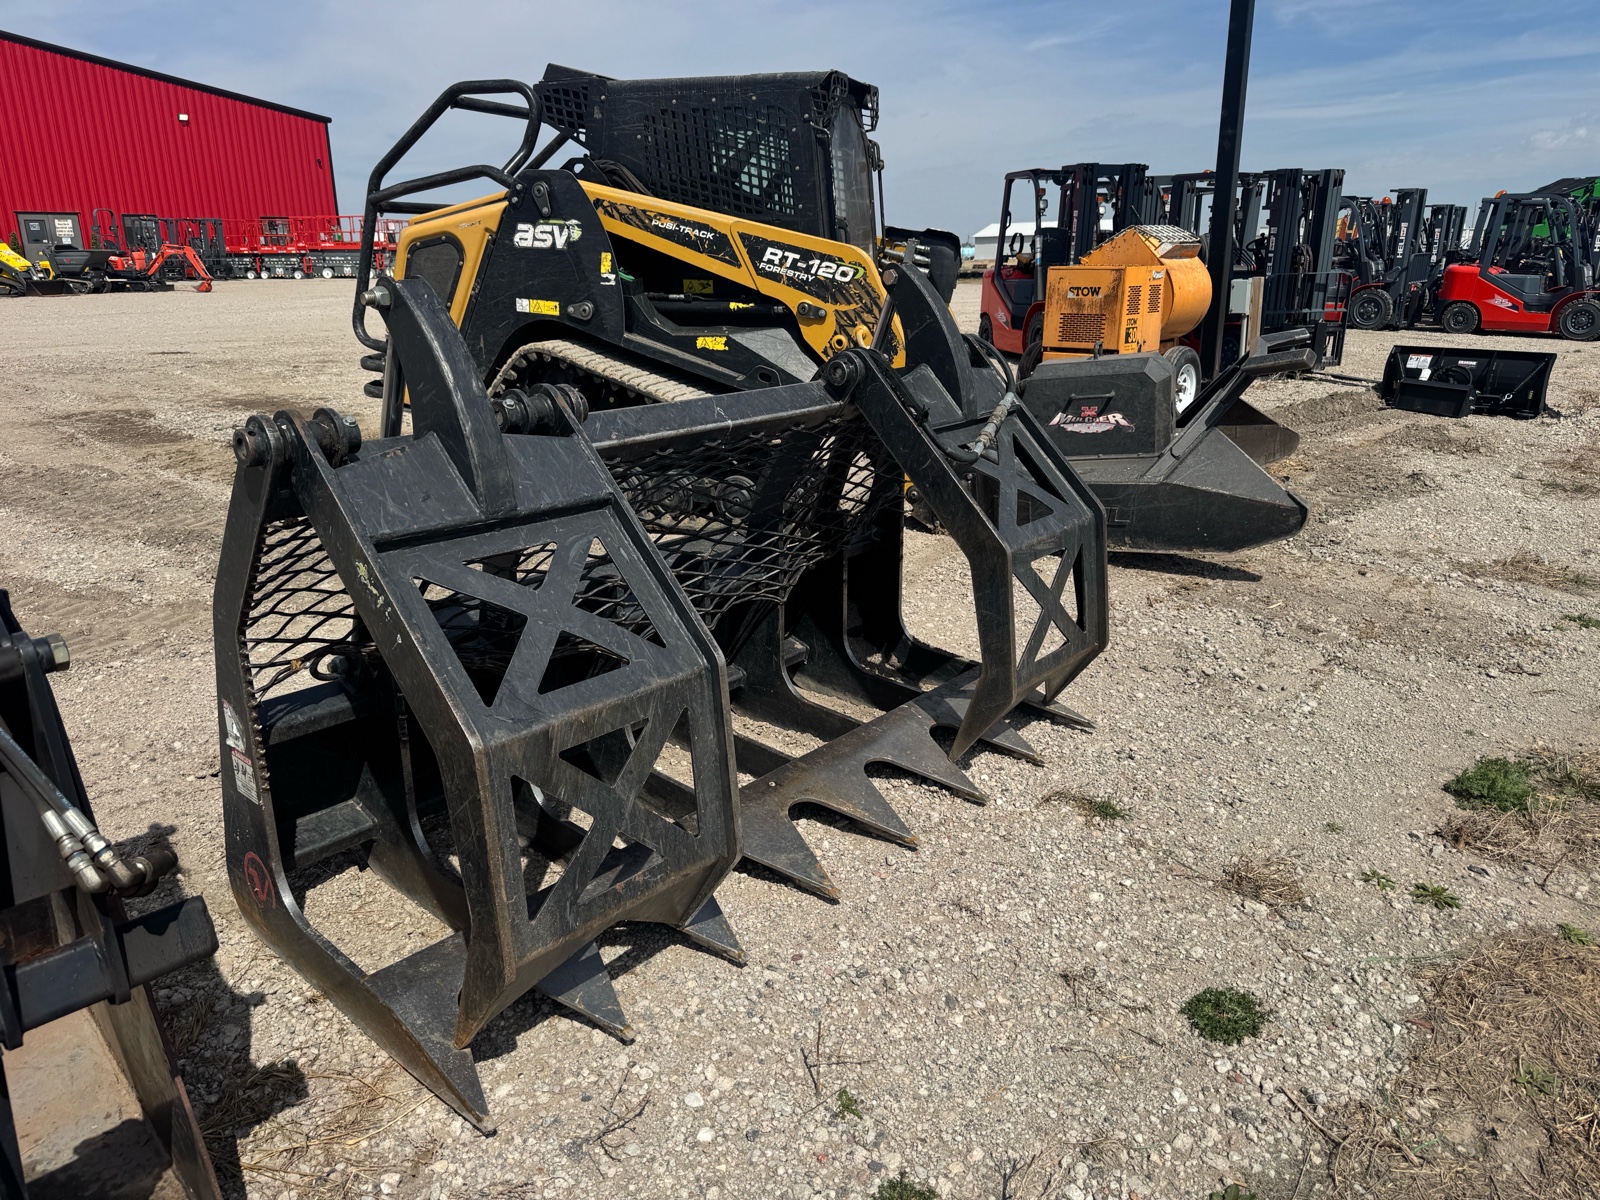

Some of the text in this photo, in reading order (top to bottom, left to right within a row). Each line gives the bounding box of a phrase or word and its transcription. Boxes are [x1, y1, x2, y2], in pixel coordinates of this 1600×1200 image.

[651, 219, 715, 240] POSI-TRACK
[759, 262, 815, 282] FORESTRY
[762, 247, 854, 283] RT-120
[1068, 287, 1101, 297] STOW
[1126, 317, 1138, 327] STOW
